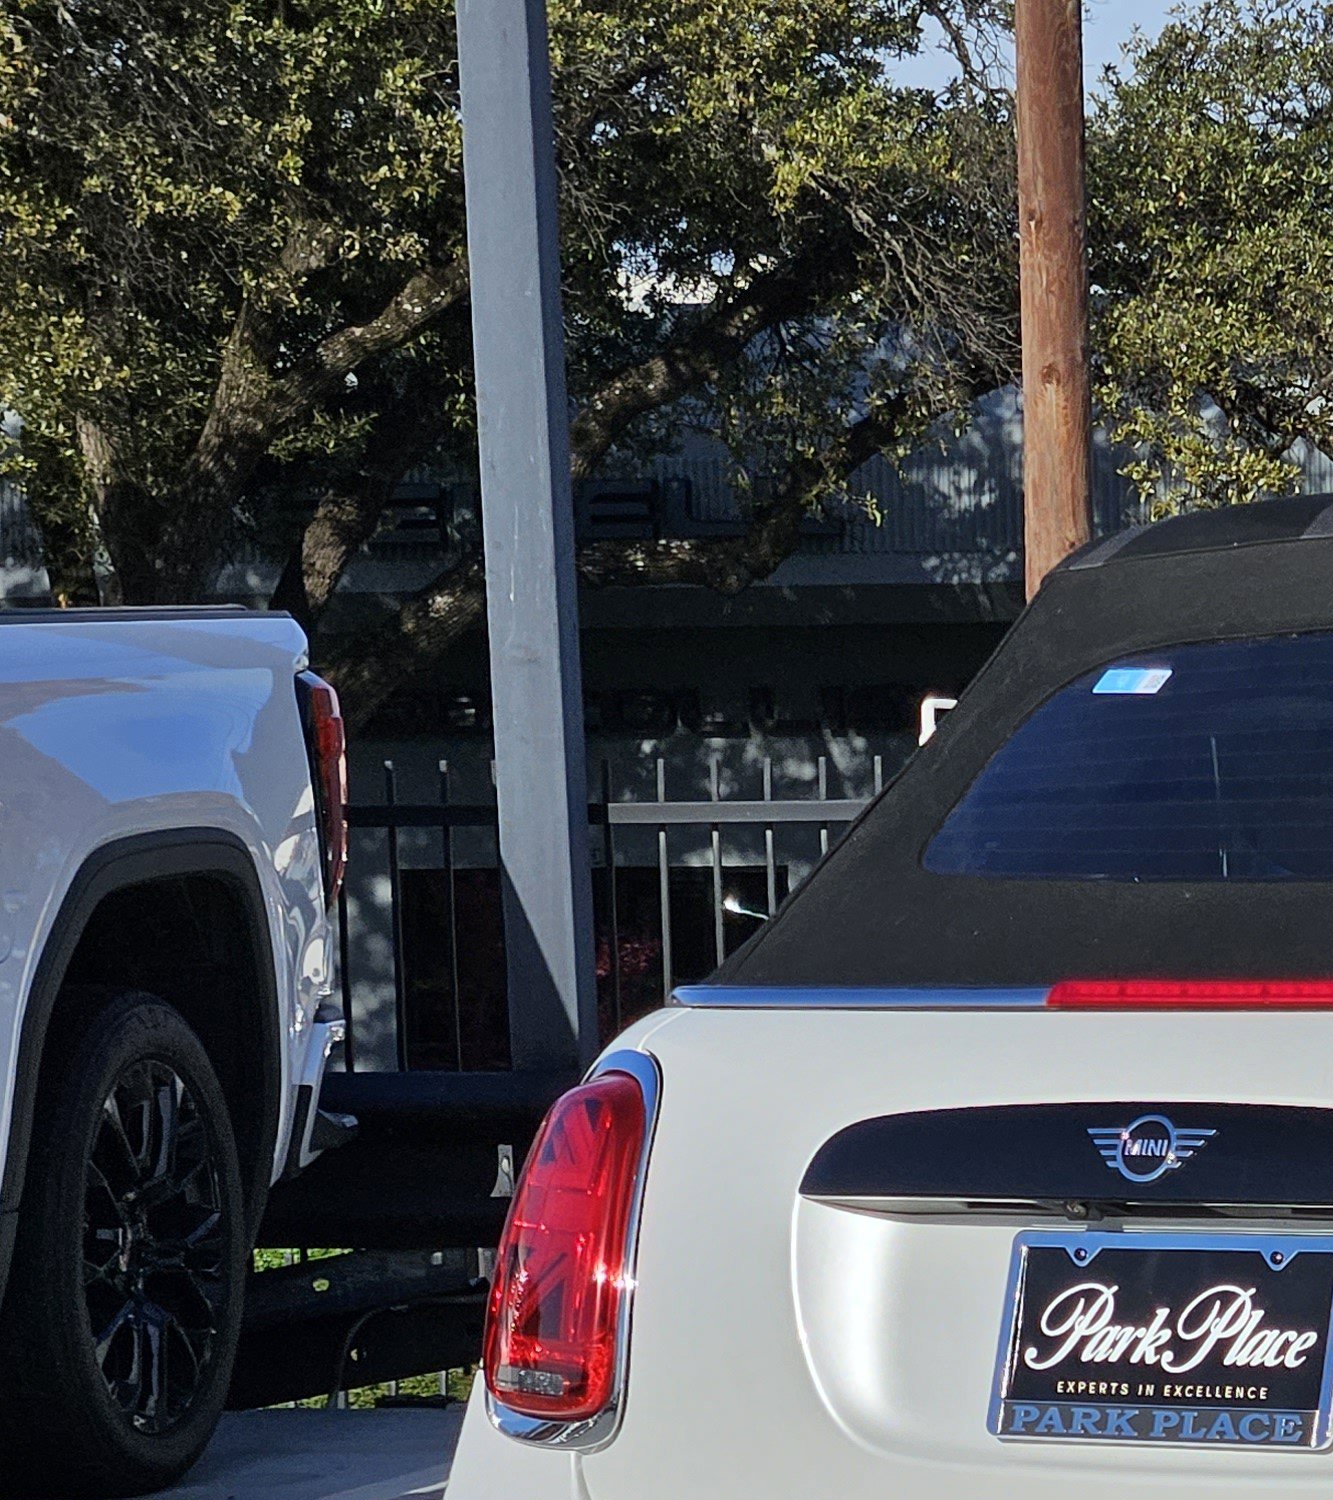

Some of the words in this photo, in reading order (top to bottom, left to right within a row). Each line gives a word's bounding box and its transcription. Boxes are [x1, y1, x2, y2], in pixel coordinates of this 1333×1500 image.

[1123, 1138, 1169, 1157] MINI
[1024, 1282, 1171, 1371] Park
[1160, 1284, 1318, 1375] Place
[1056, 1380, 1130, 1397] EXPERTS
[1137, 1383, 1155, 1398] IN
[1163, 1384, 1269, 1401] EXCELLENCE
[1009, 1404, 1139, 1438] PARK
[1151, 1409, 1304, 1443] PLACE
